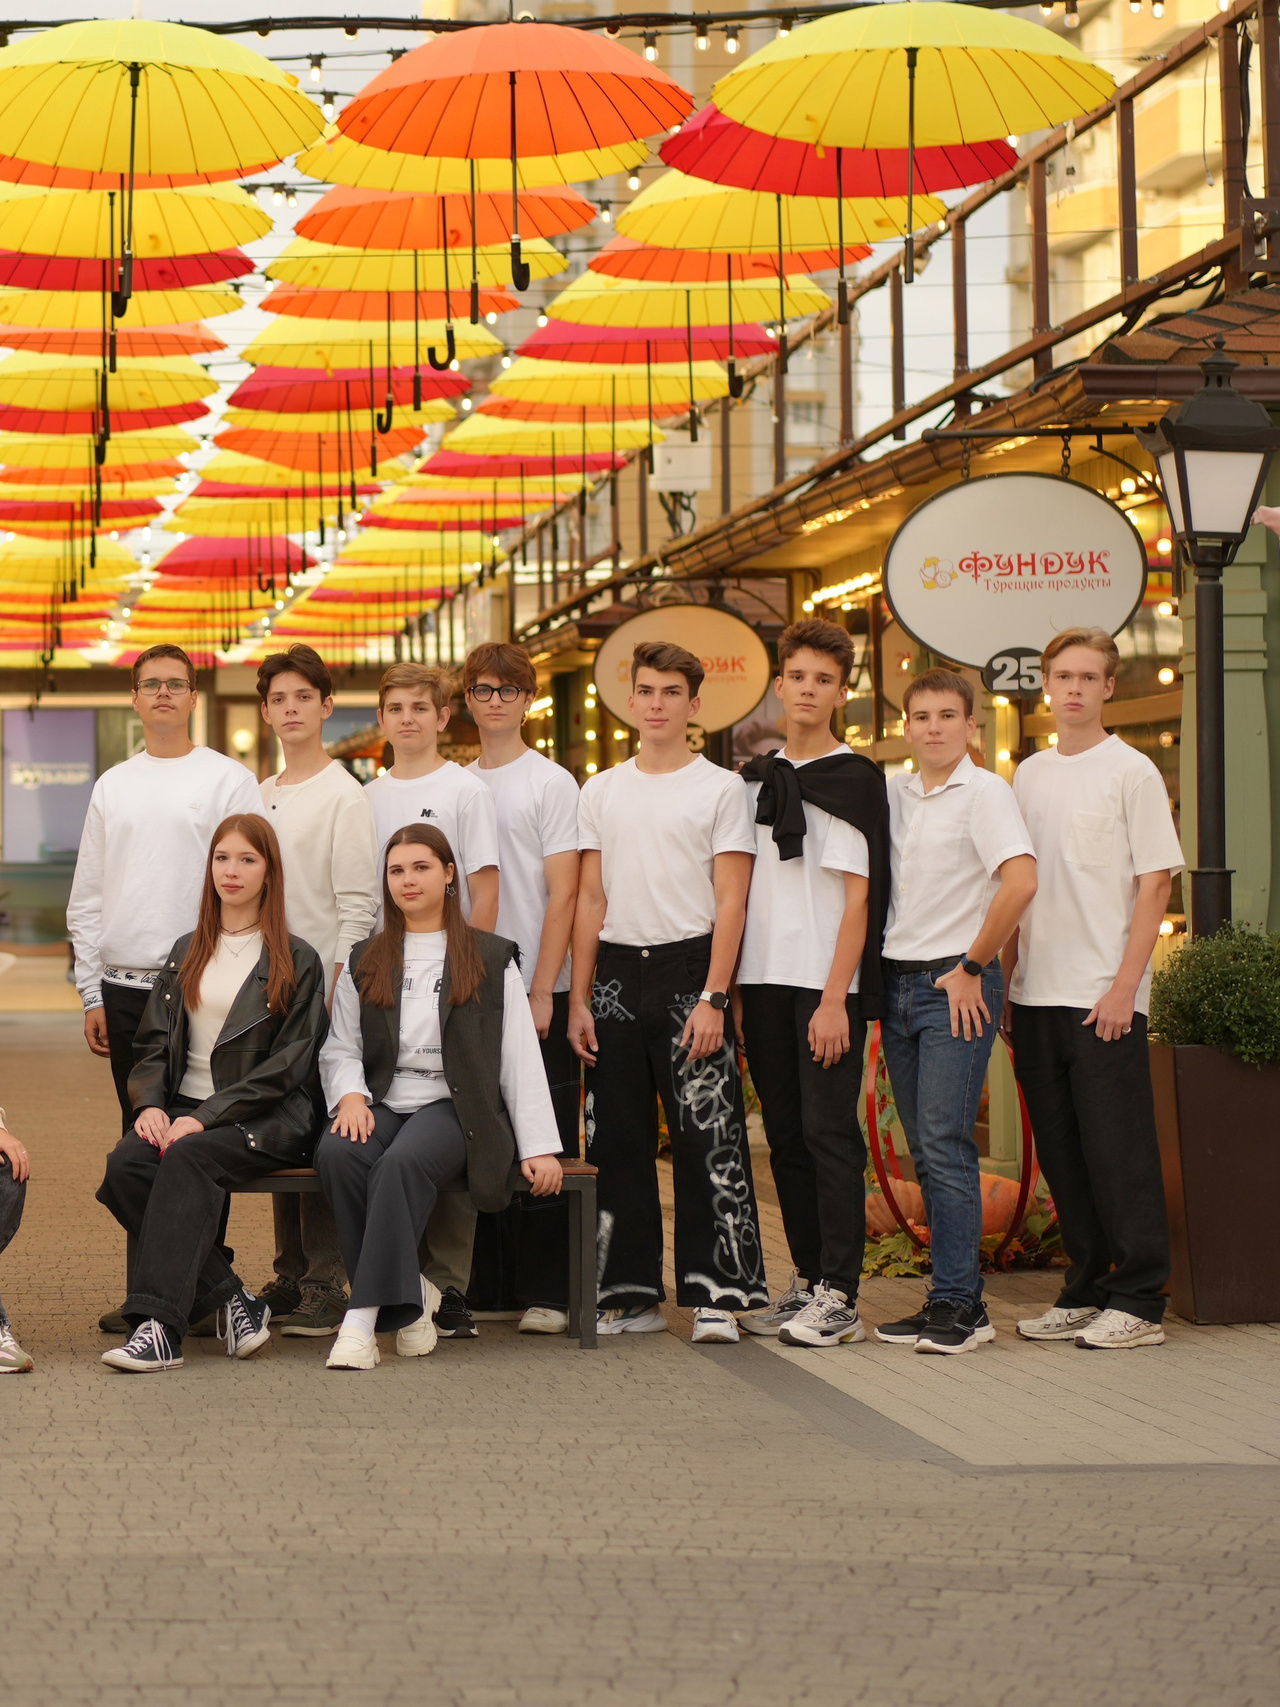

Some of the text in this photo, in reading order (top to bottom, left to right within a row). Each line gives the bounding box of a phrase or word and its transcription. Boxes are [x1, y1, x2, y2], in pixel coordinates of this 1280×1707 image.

[958, 550, 1111, 585] ФУНДУК
[984, 577, 1111, 594] Турецкие продукты
[992, 655, 1044, 691] 25
[686, 726, 705, 751] 3
